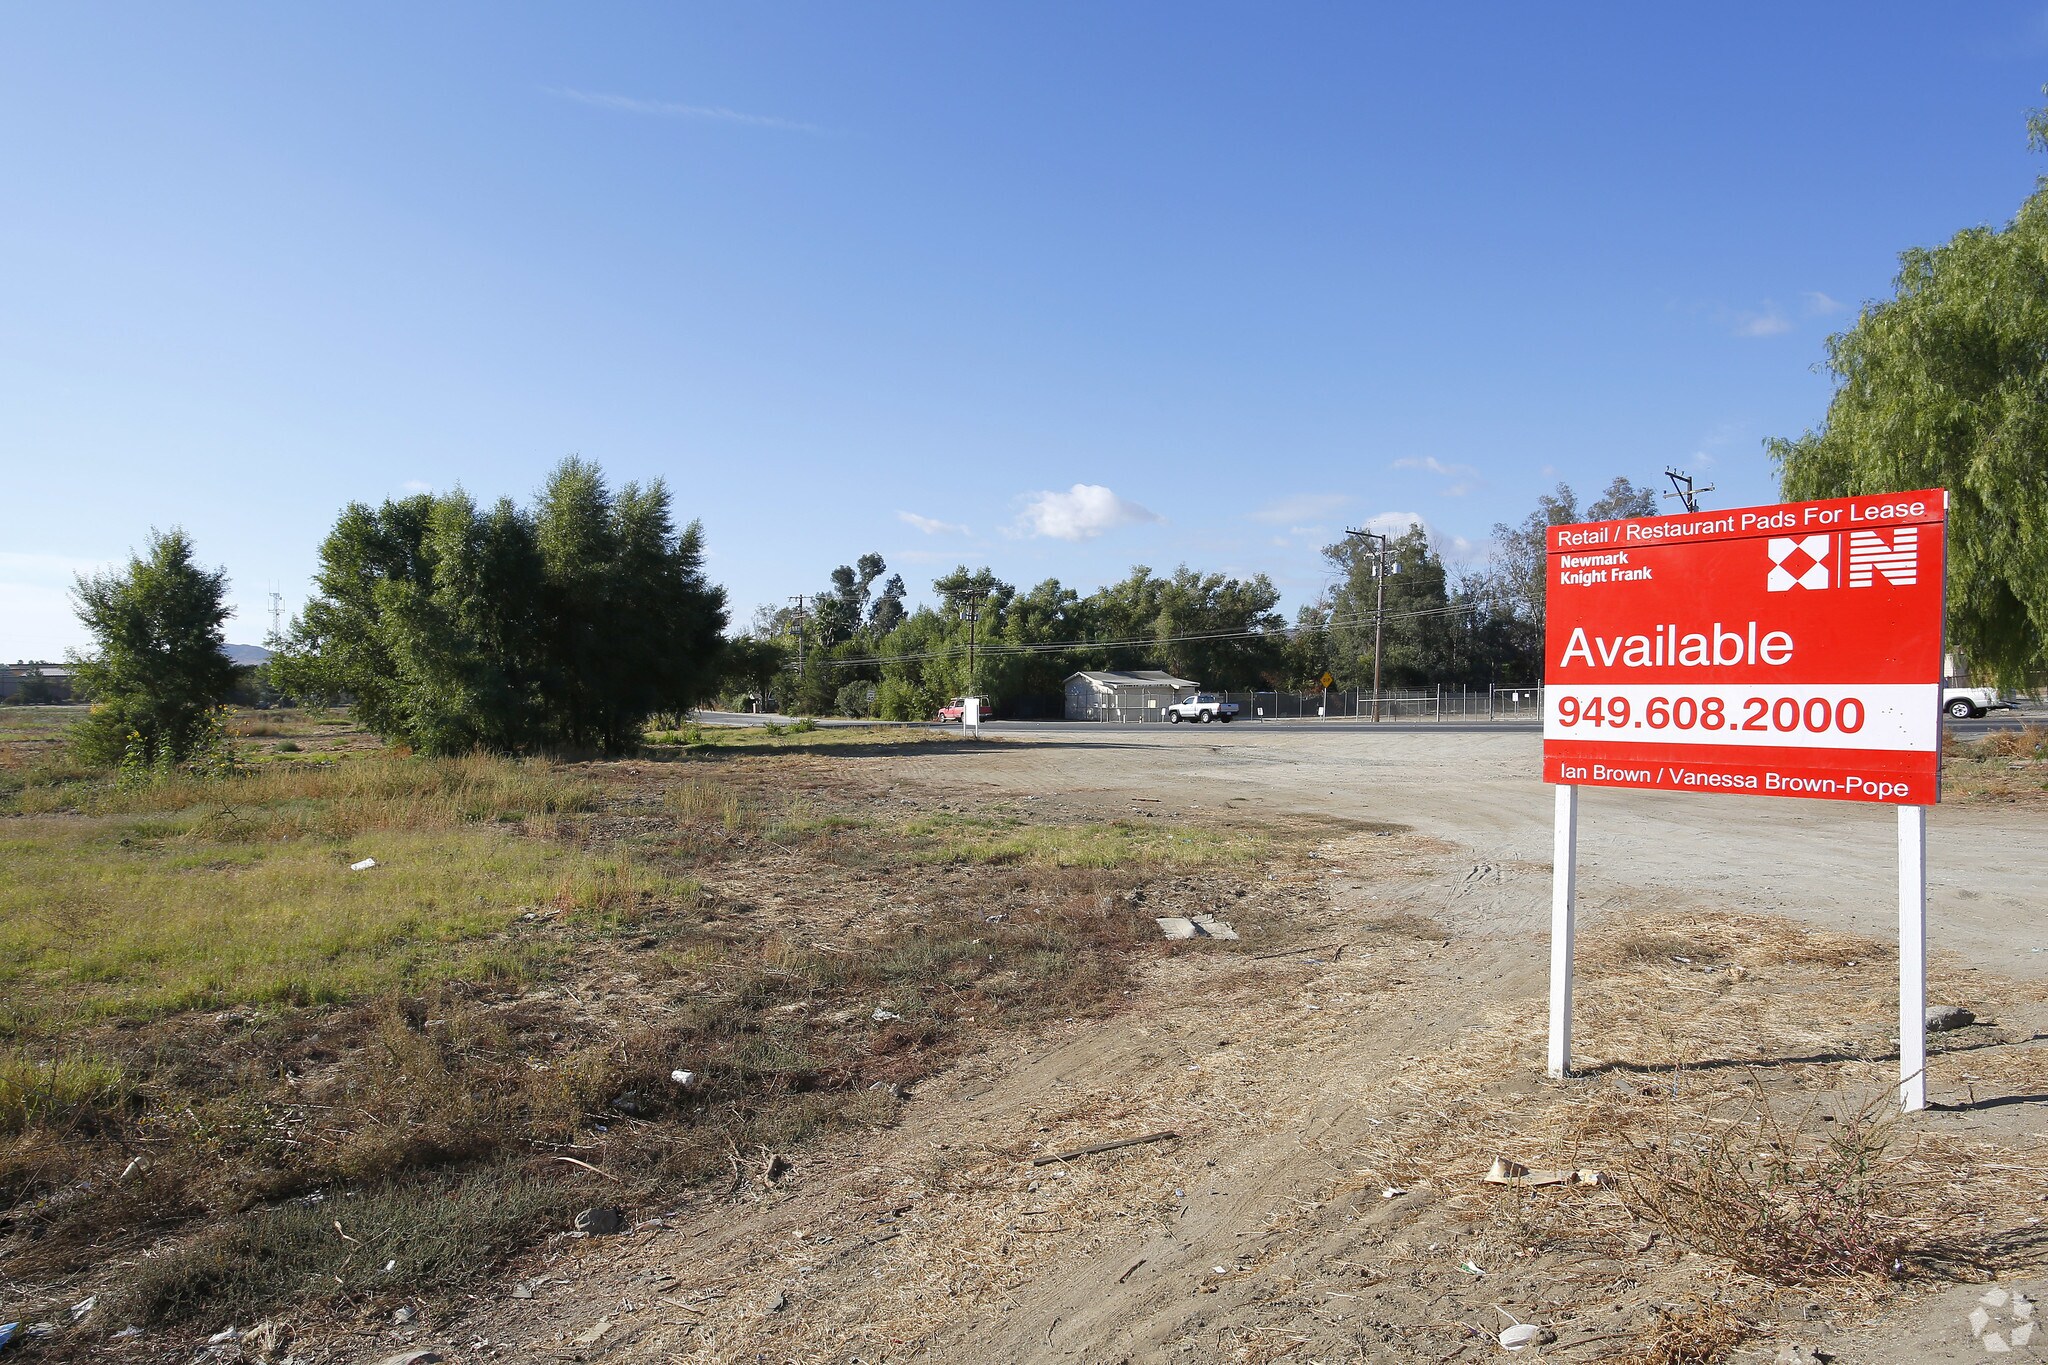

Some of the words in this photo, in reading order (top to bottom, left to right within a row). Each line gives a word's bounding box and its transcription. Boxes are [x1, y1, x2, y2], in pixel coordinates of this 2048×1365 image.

[1558, 527, 1609, 547] Retail
[1614, 525, 1621, 543] /
[1627, 517, 1735, 541] Restaurant
[1742, 511, 1796, 531] Pads
[1805, 507, 1844, 526] For
[1851, 502, 1926, 522] Lease
[1560, 569, 1607, 586] Knight
[1612, 566, 1653, 582] Frank
[1561, 551, 1628, 569] Newmark
[1560, 622, 1794, 668] Available
[1558, 696, 1865, 734] 949.608.2000
[1562, 763, 1587, 780] Ian
[1594, 765, 1651, 783] Brown
[1657, 768, 1664, 784] /
[1669, 768, 1758, 789] Vanessa
[1765, 773, 1909, 800] Brown-Pope
